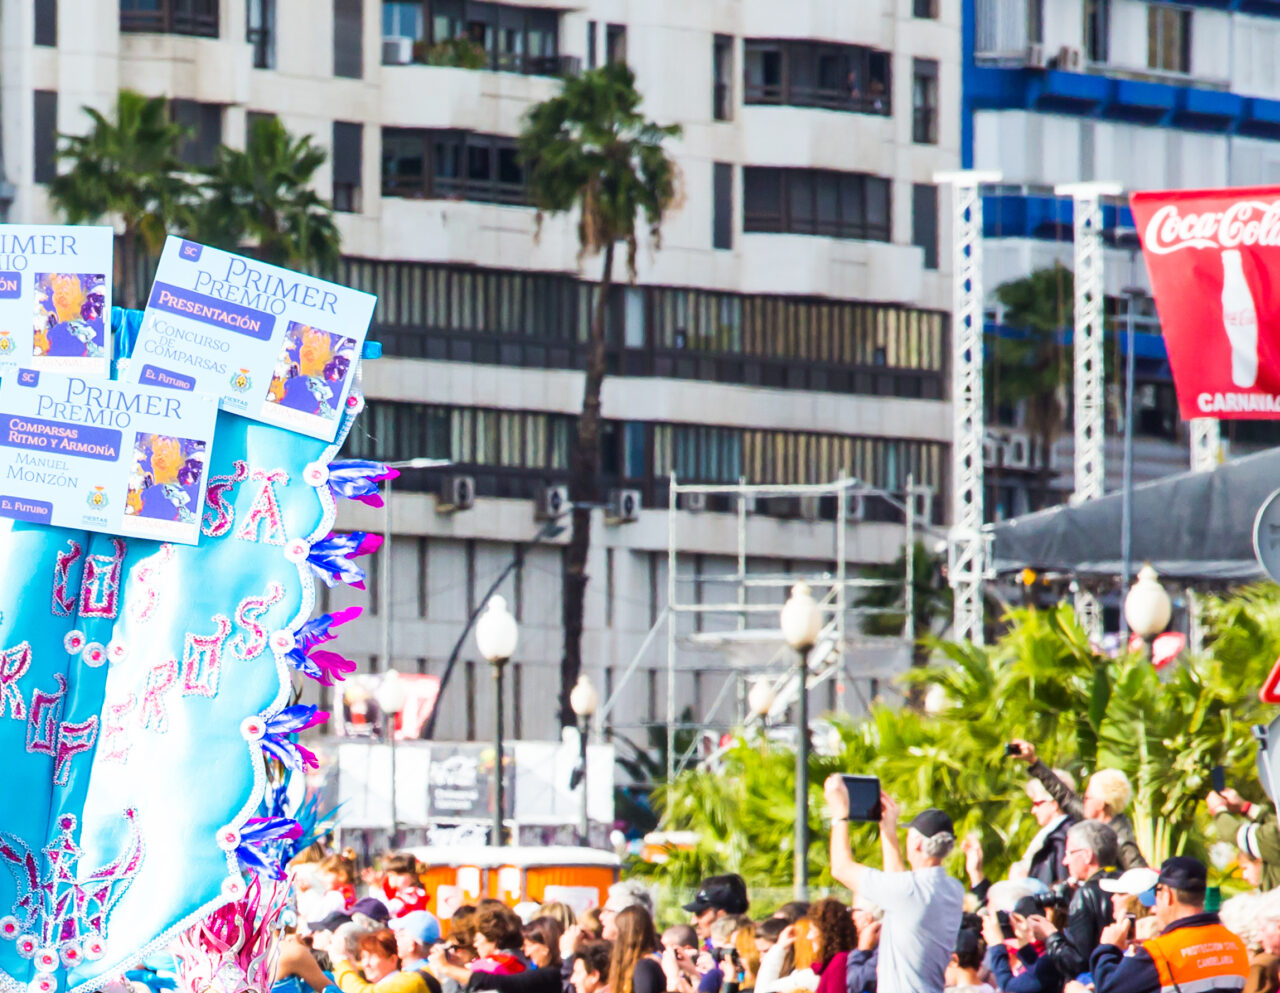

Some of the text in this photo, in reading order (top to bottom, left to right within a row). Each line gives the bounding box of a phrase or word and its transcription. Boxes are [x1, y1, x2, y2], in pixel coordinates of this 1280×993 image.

[184, 246, 197, 257] SC
[193, 270, 286, 315] PREMIO
[223, 257, 338, 314] PRIMER
[158, 290, 261, 332] PRESENTACIÓN
[154, 319, 230, 353] CONCURSO
[158, 335, 175, 347] DE
[144, 339, 228, 375] COMPARSAS
[22, 373, 35, 383] SC
[145, 368, 191, 390] EL FUTURO
[66, 377, 182, 420] PRIMER
[36, 394, 131, 428] PREMIO
[9, 418, 78, 439] COMPARSAS
[8, 431, 116, 457] RITMO Y ARMONÍA
[15, 452, 69, 471] MANUEL
[6, 465, 79, 488] MONZÓN
[1, 500, 48, 515] EL FUTURO
